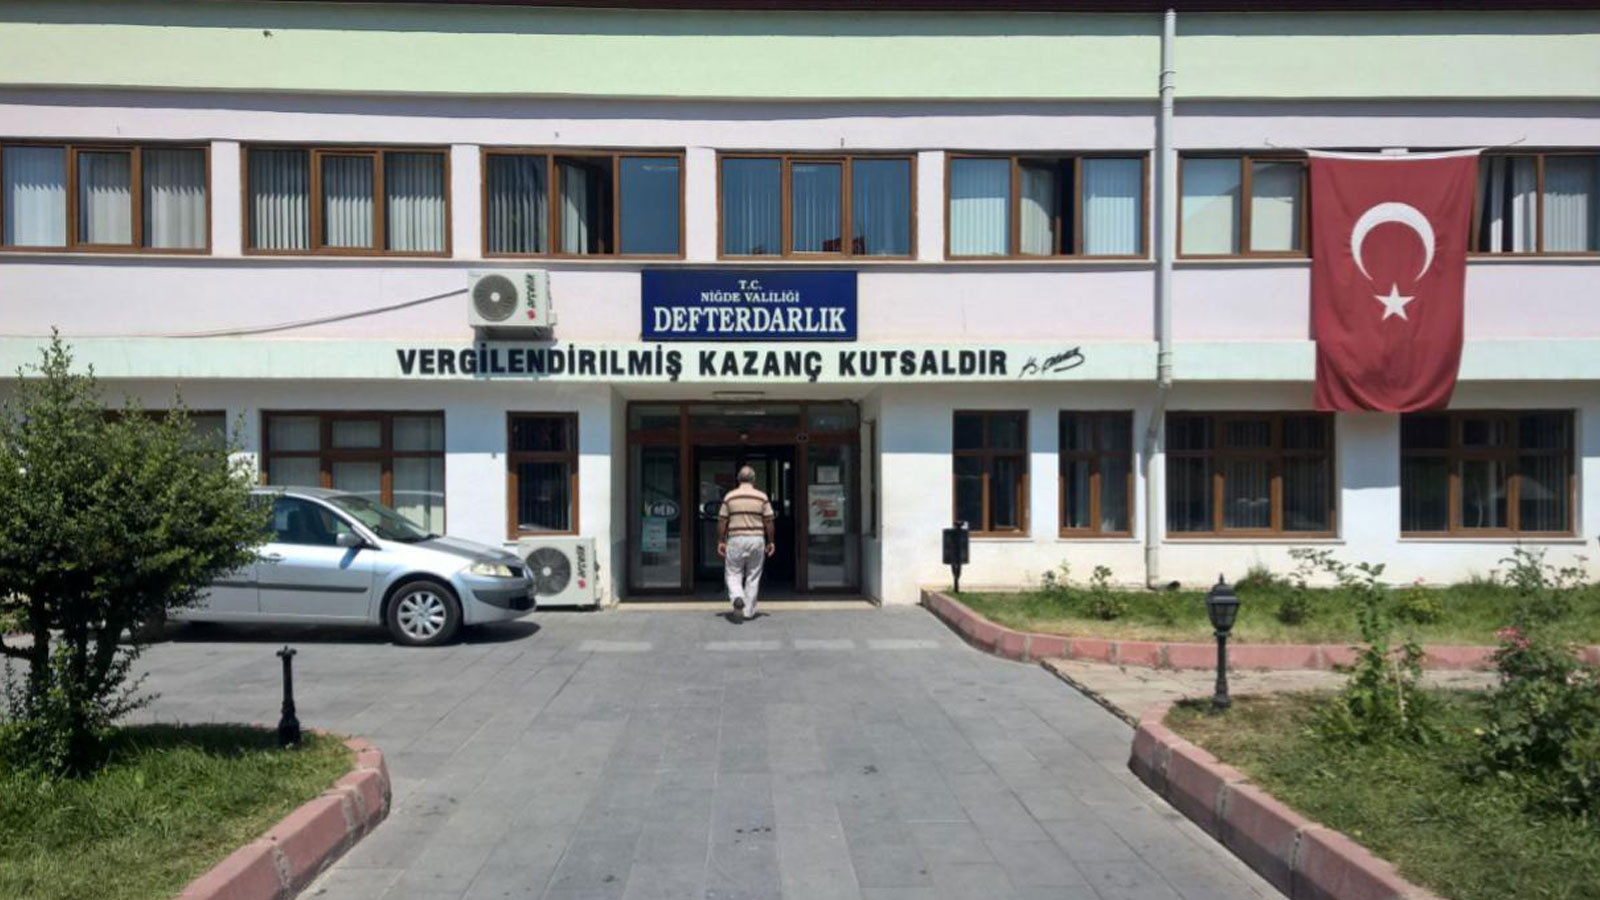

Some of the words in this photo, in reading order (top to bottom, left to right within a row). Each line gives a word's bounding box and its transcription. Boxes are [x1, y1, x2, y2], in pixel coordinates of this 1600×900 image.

[738, 280, 762, 290] T.C.
[700, 292, 741, 302] NİĞDE
[745, 292, 800, 302] VALİLİĞİ
[653, 306, 846, 332] DEFTERDARLIK
[397, 343, 683, 382] VERGİLENDİRİLMİŞ
[698, 350, 822, 382] KAZANÇ
[838, 350, 1008, 376] KUTSALDIR
